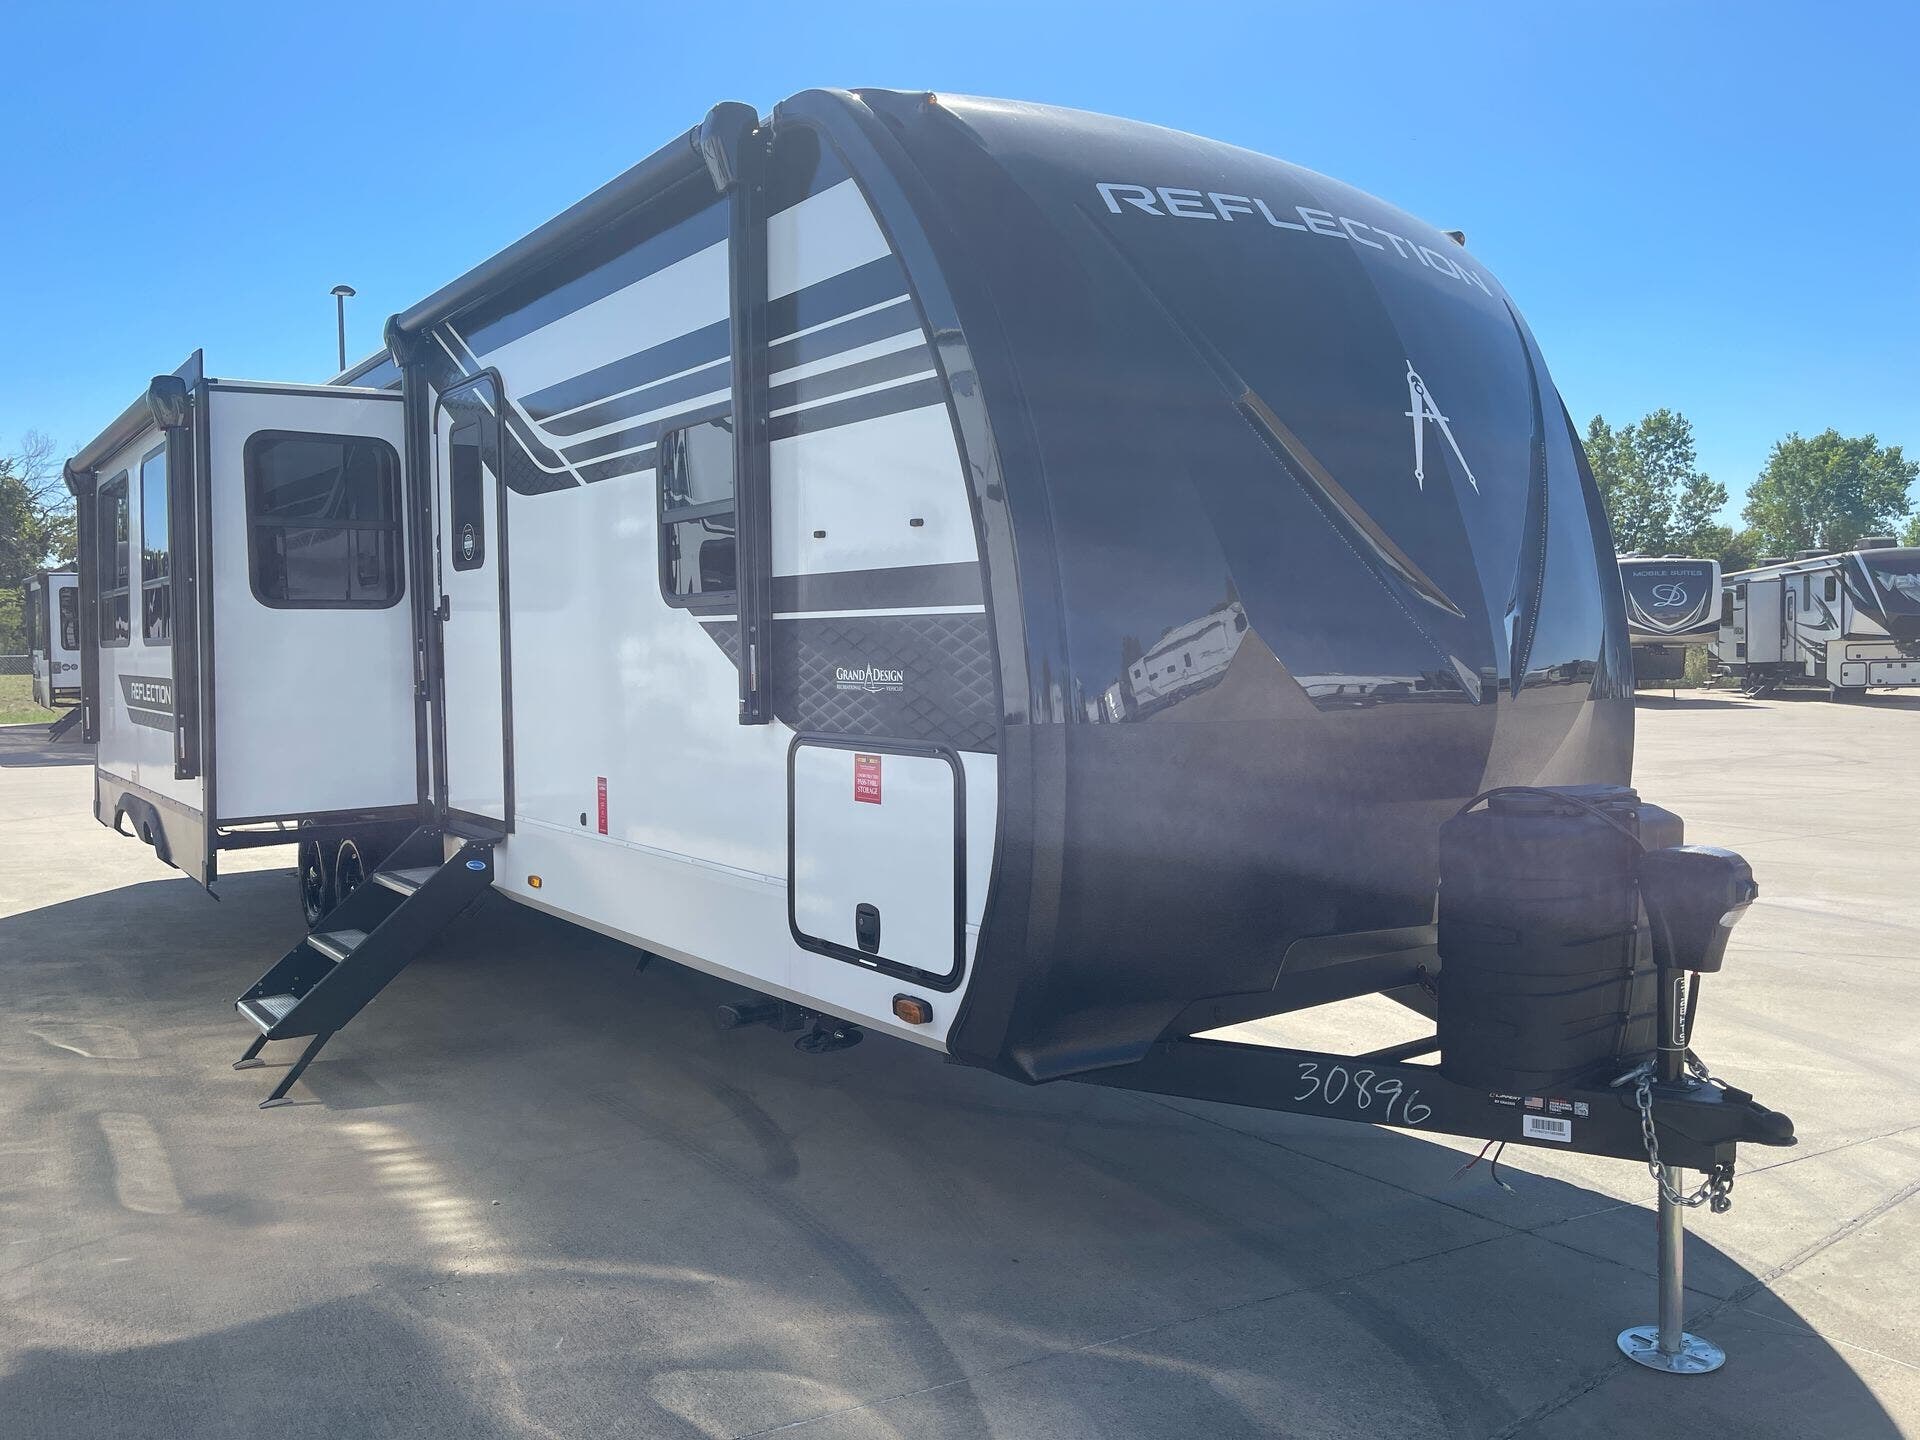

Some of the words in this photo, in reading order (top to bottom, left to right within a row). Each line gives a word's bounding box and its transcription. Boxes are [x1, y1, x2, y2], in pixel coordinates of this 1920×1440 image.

[1096, 183, 1493, 297] REFLECTION
[130, 682, 172, 705] REFLECTION
[836, 667, 865, 681] GRAND
[873, 668, 904, 682] DESIGN
[1294, 1063, 1431, 1124] 30896
